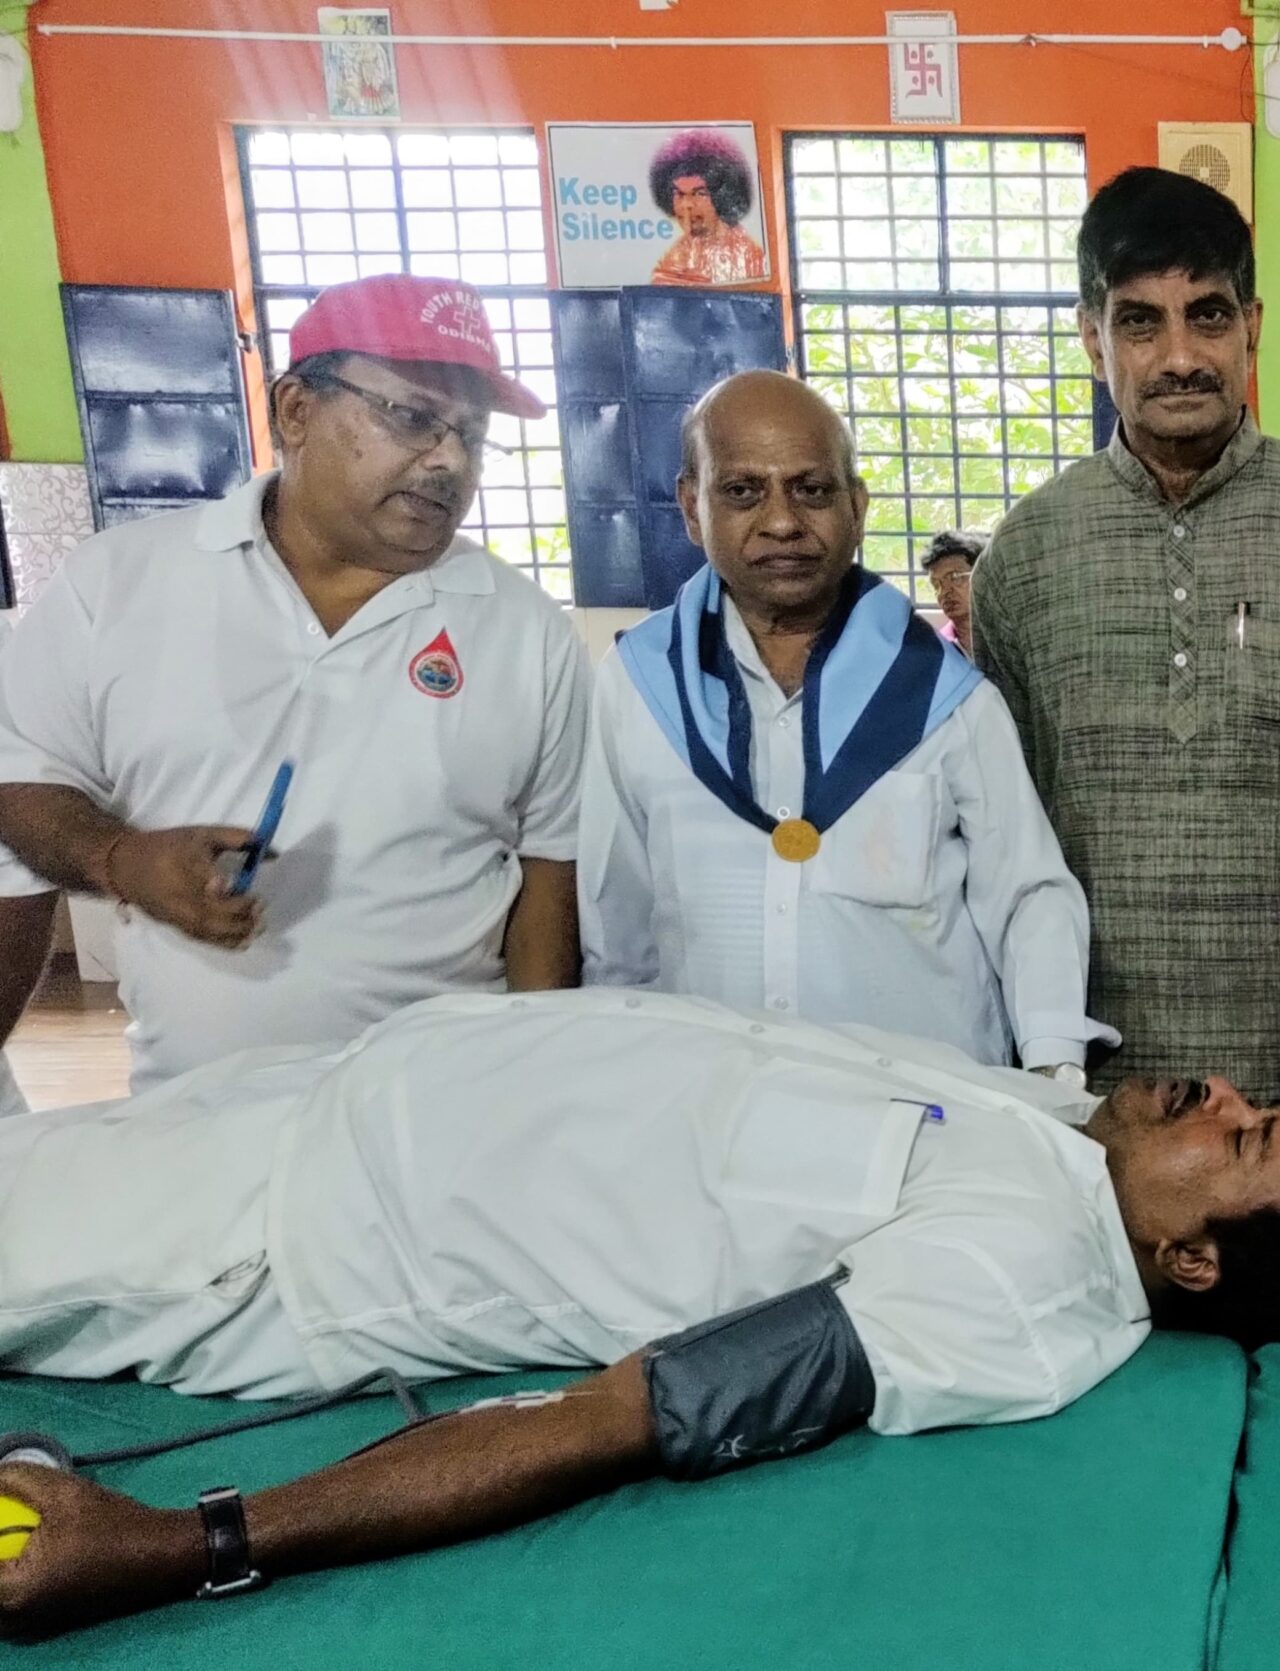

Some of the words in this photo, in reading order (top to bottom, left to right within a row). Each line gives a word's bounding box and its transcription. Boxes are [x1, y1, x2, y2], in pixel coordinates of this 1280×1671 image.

[558, 176, 638, 213] Keep
[562, 212, 674, 241] Silence
[420, 290, 453, 324] YOUTH
